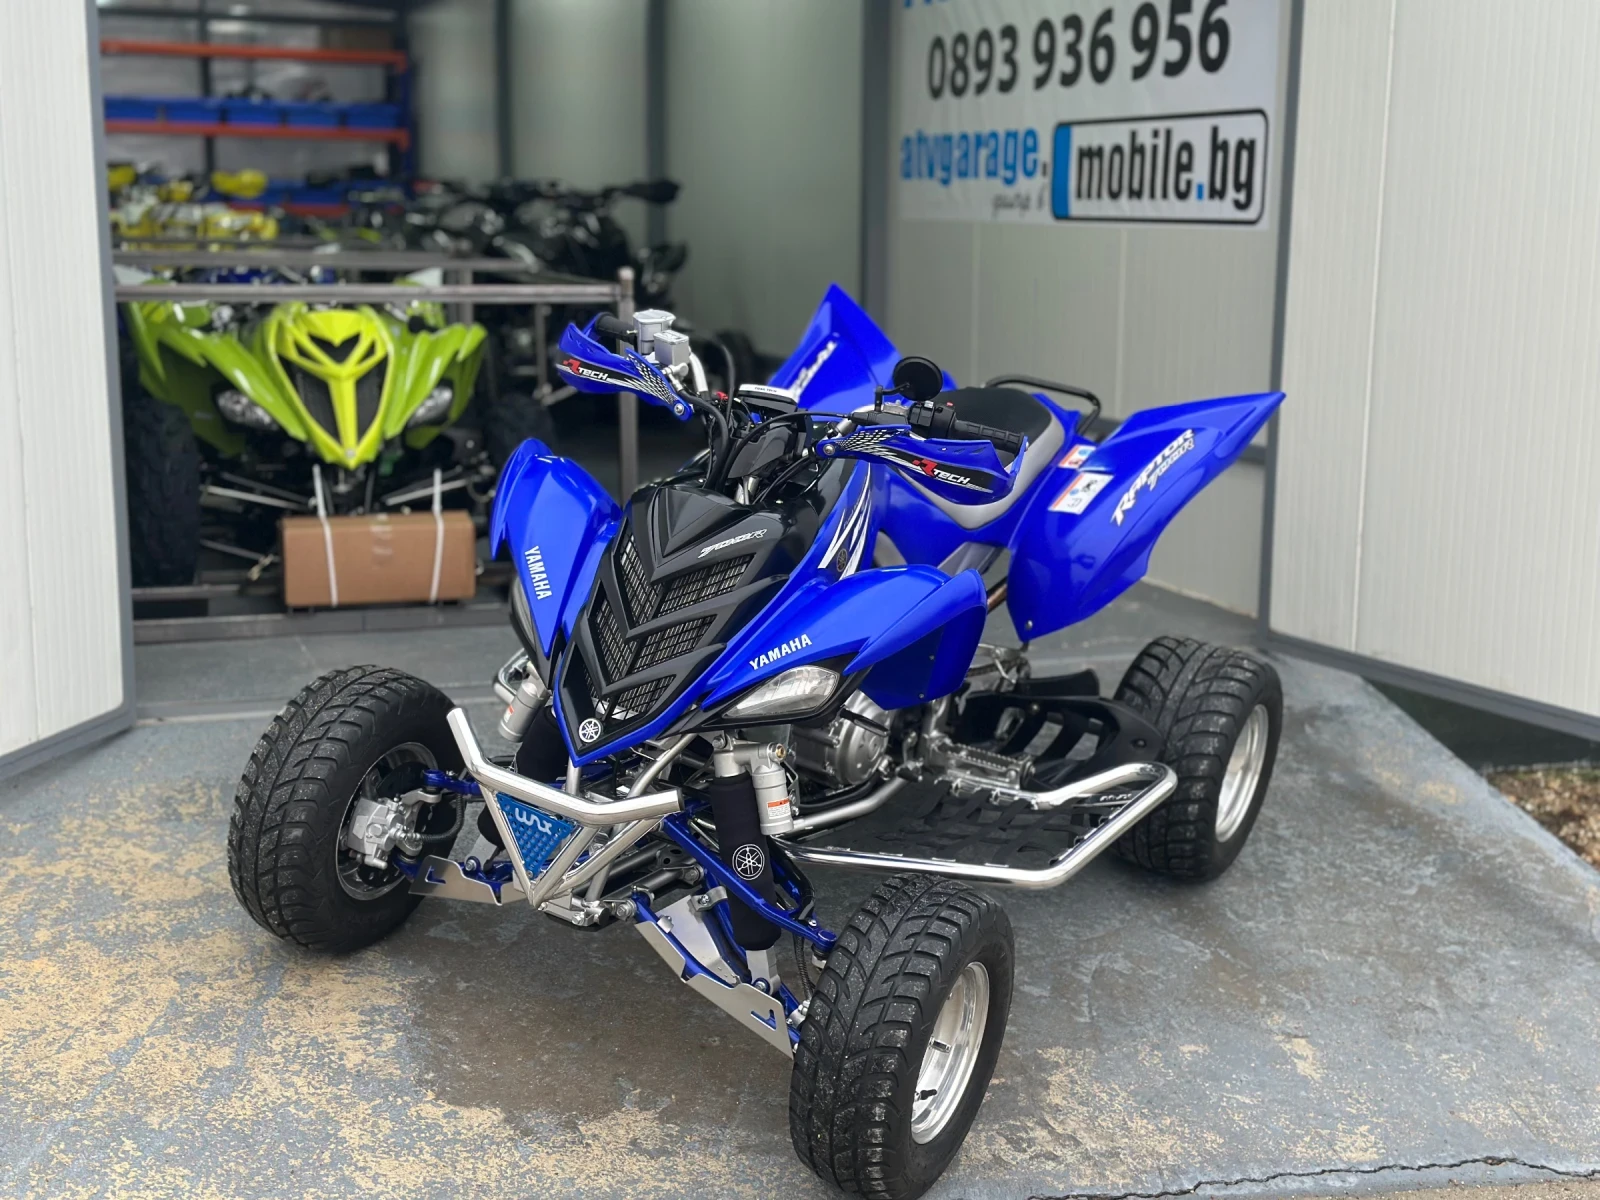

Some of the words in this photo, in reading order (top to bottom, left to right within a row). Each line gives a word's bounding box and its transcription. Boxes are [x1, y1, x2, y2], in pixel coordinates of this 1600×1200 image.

[928, 24, 1018, 100] 0893
[1033, 9, 1115, 90] 936
[1131, 0, 1230, 81] 956
[1076, 125, 1256, 211] mobile.bg
[524, 545, 553, 600] YAMAHA
[749, 634, 813, 670] YAMAHA
